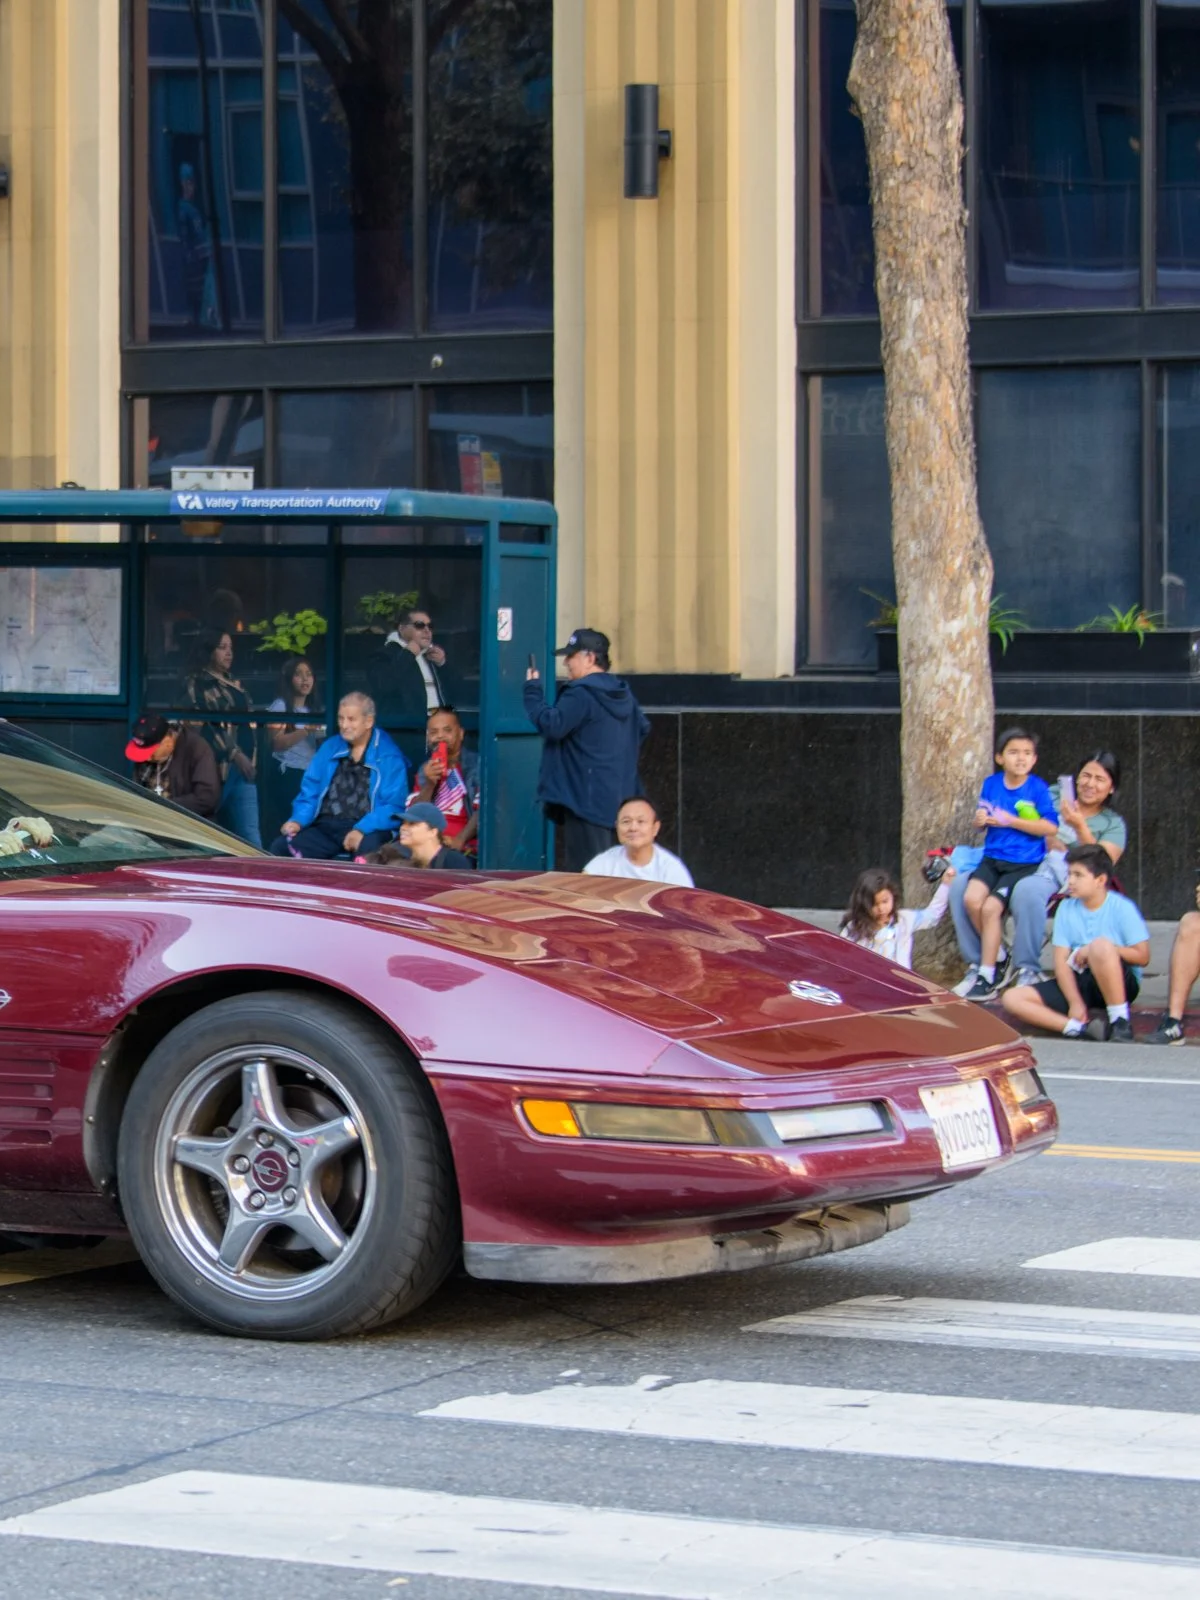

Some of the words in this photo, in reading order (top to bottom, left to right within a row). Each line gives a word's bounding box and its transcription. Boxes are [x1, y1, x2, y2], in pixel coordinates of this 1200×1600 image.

[205, 497, 239, 510] Valley
[242, 496, 323, 511] Transportation
[326, 495, 381, 511] Authority
